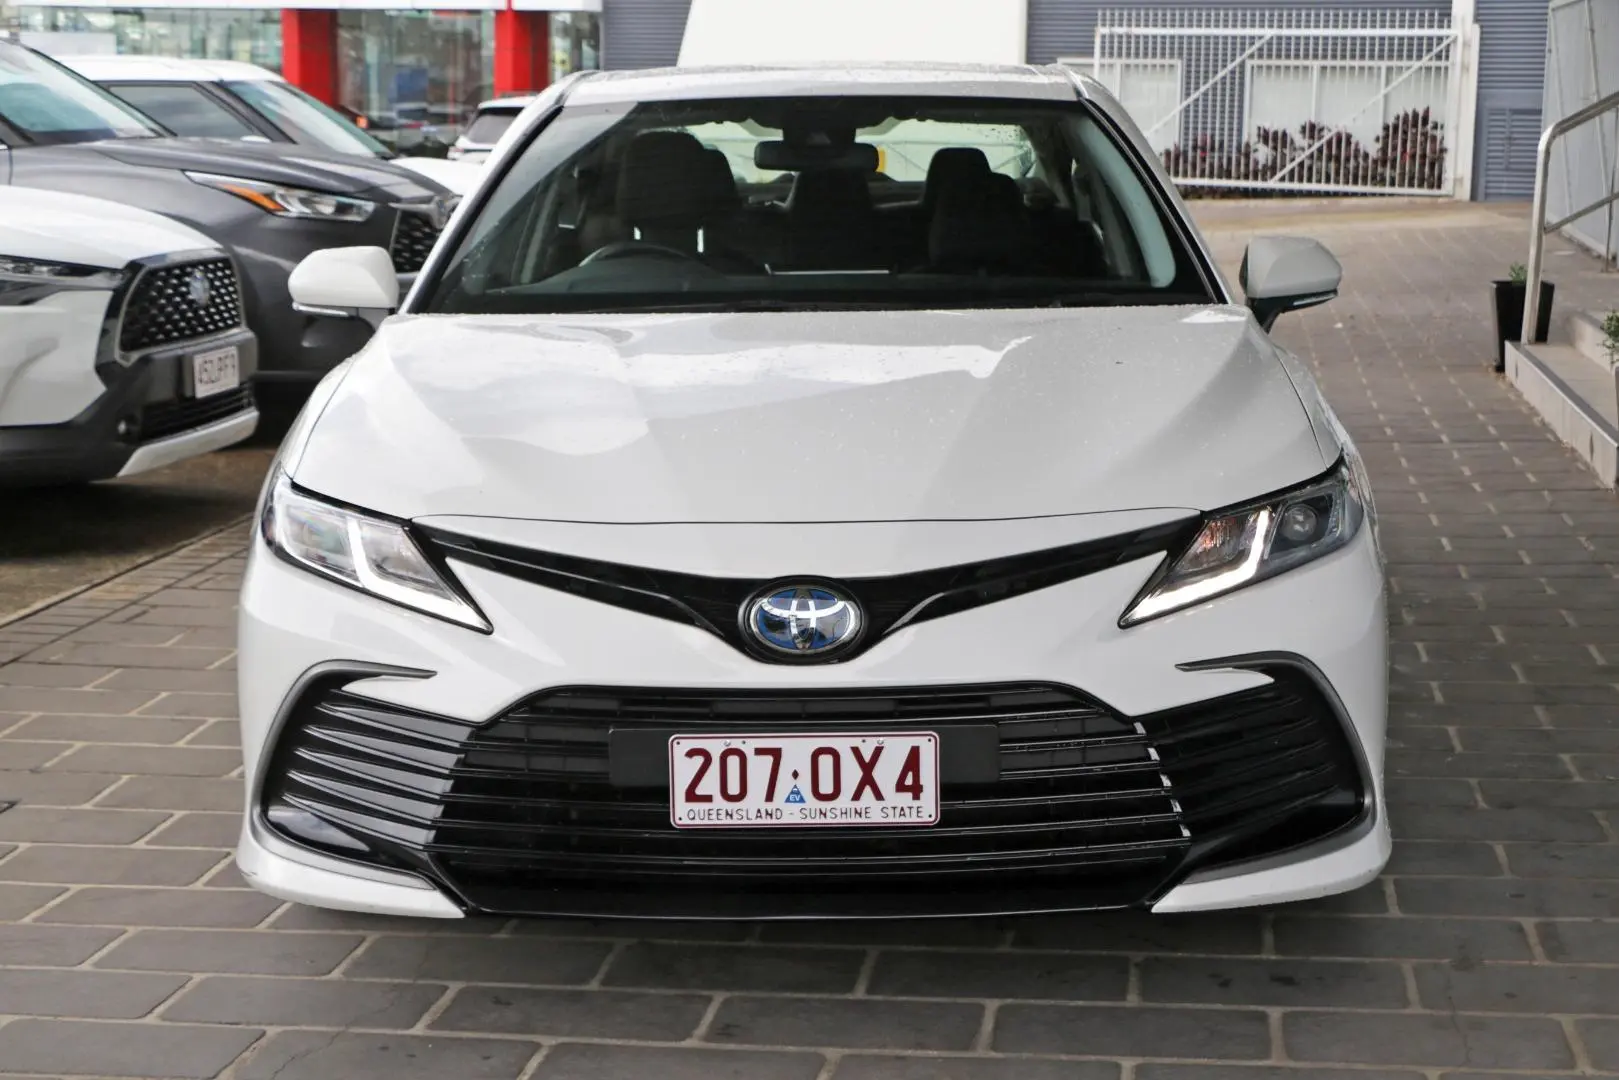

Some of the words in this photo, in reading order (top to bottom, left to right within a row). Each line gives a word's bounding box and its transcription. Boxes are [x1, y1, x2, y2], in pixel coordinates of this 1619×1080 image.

[684, 748, 782, 803] 207
[789, 794, 801, 802] EV
[687, 809, 783, 821] QUEENSLAND
[800, 807, 871, 819] SUNSHINE
[881, 806, 923, 818] STATE
